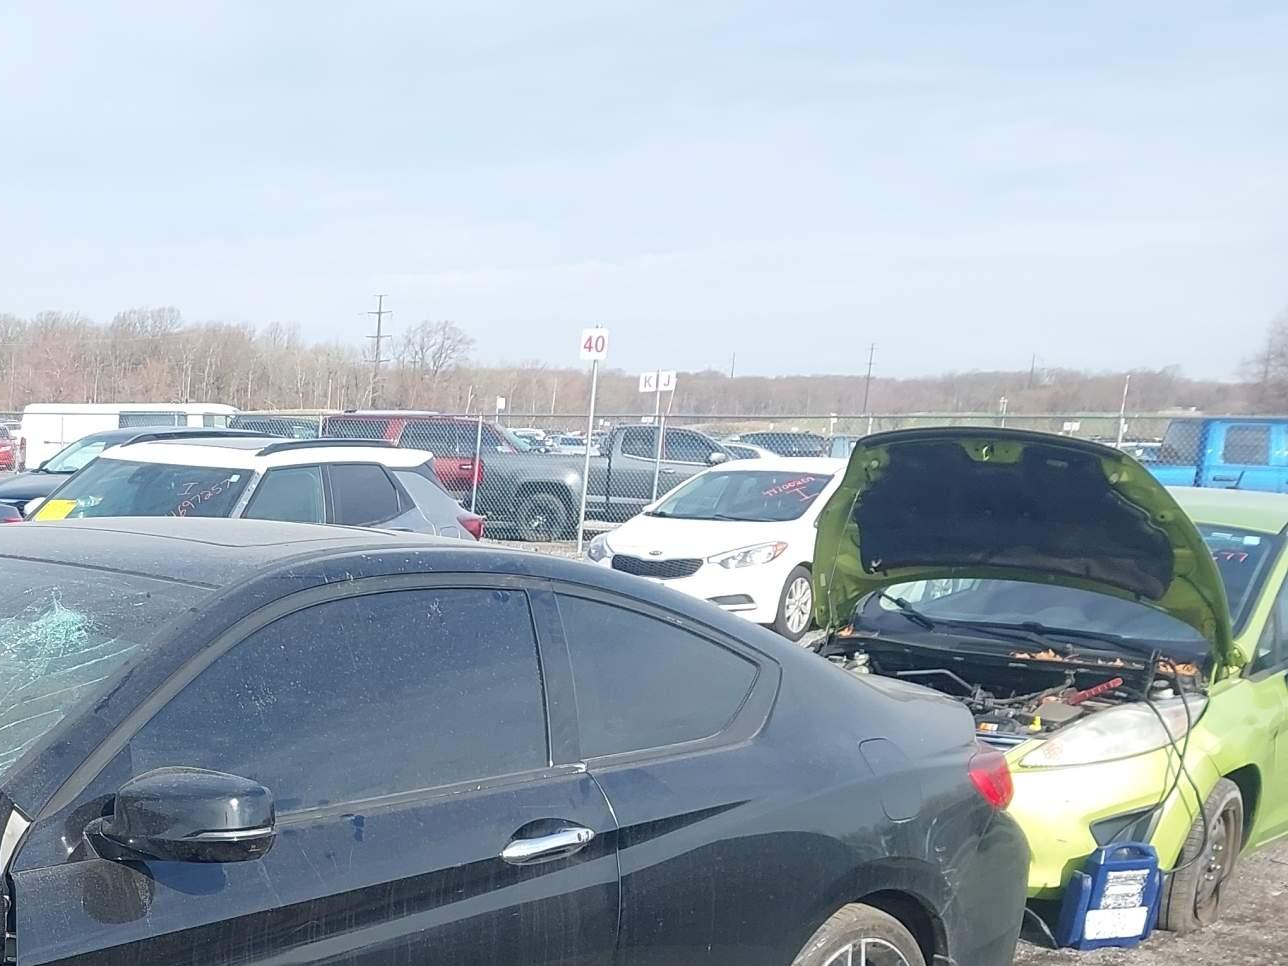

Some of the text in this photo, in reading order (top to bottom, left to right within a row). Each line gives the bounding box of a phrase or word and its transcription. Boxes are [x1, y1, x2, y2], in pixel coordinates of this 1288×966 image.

[583, 335, 605, 353] 40
[643, 374, 671, 388] K J
